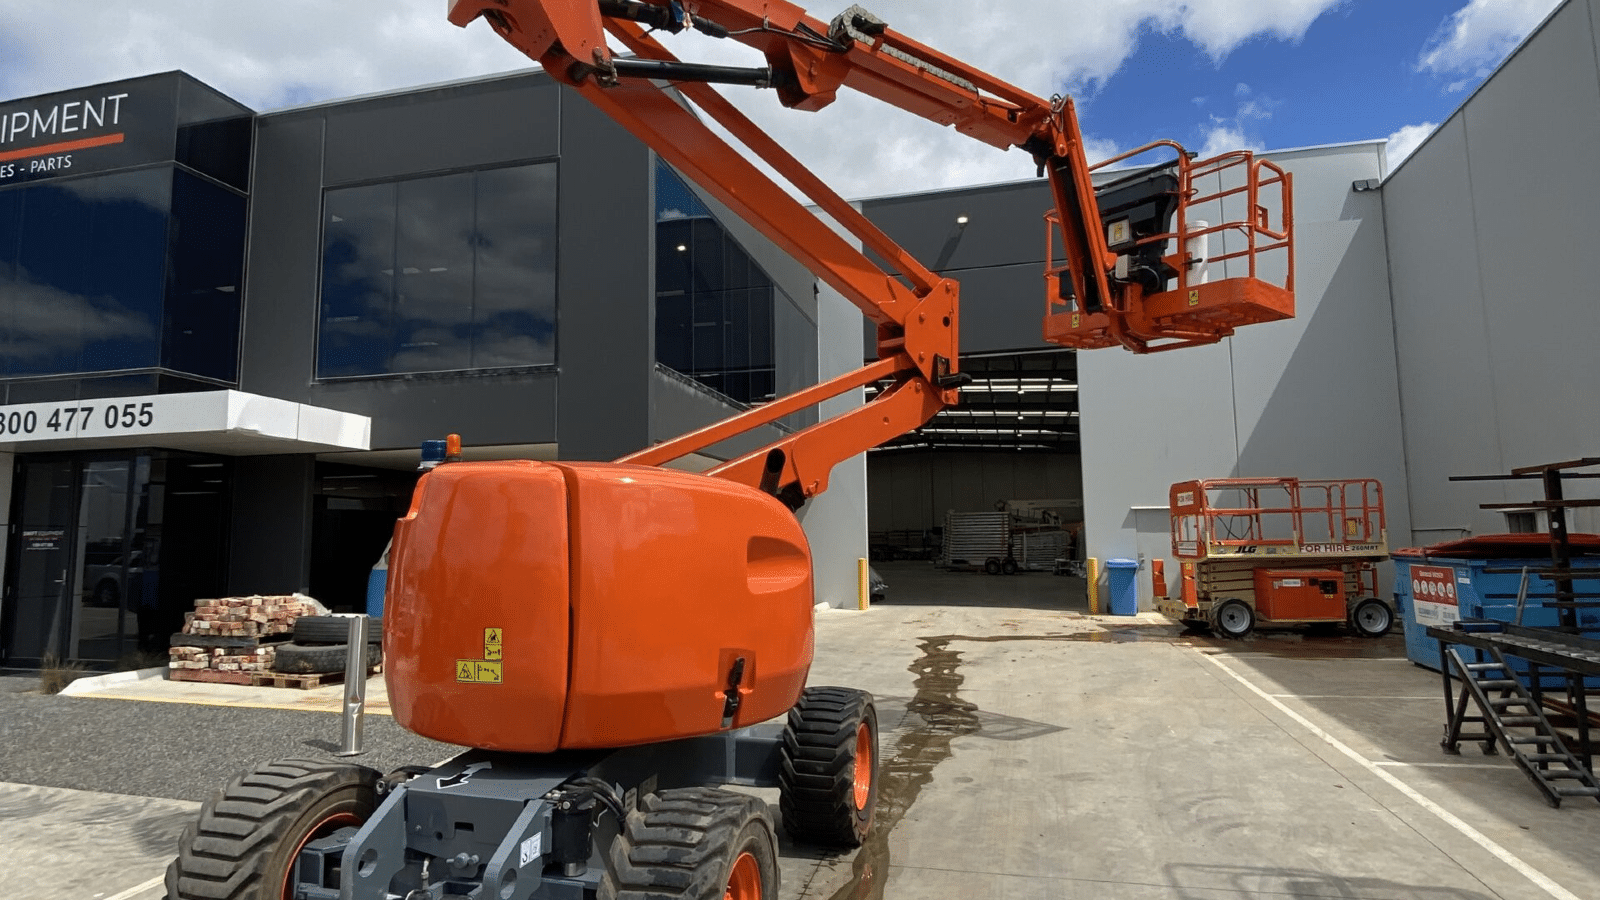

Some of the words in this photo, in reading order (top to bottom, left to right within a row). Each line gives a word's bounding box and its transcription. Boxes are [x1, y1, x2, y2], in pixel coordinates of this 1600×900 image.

[1, 93, 128, 143] IPMENT
[31, 154, 72, 173] PARTS
[47, 407, 94, 432] 477
[105, 402, 153, 428] 055
[1235, 545, 1257, 553] JLG
[1300, 544, 1321, 552] FOR
[1324, 543, 1350, 552] HIRE
